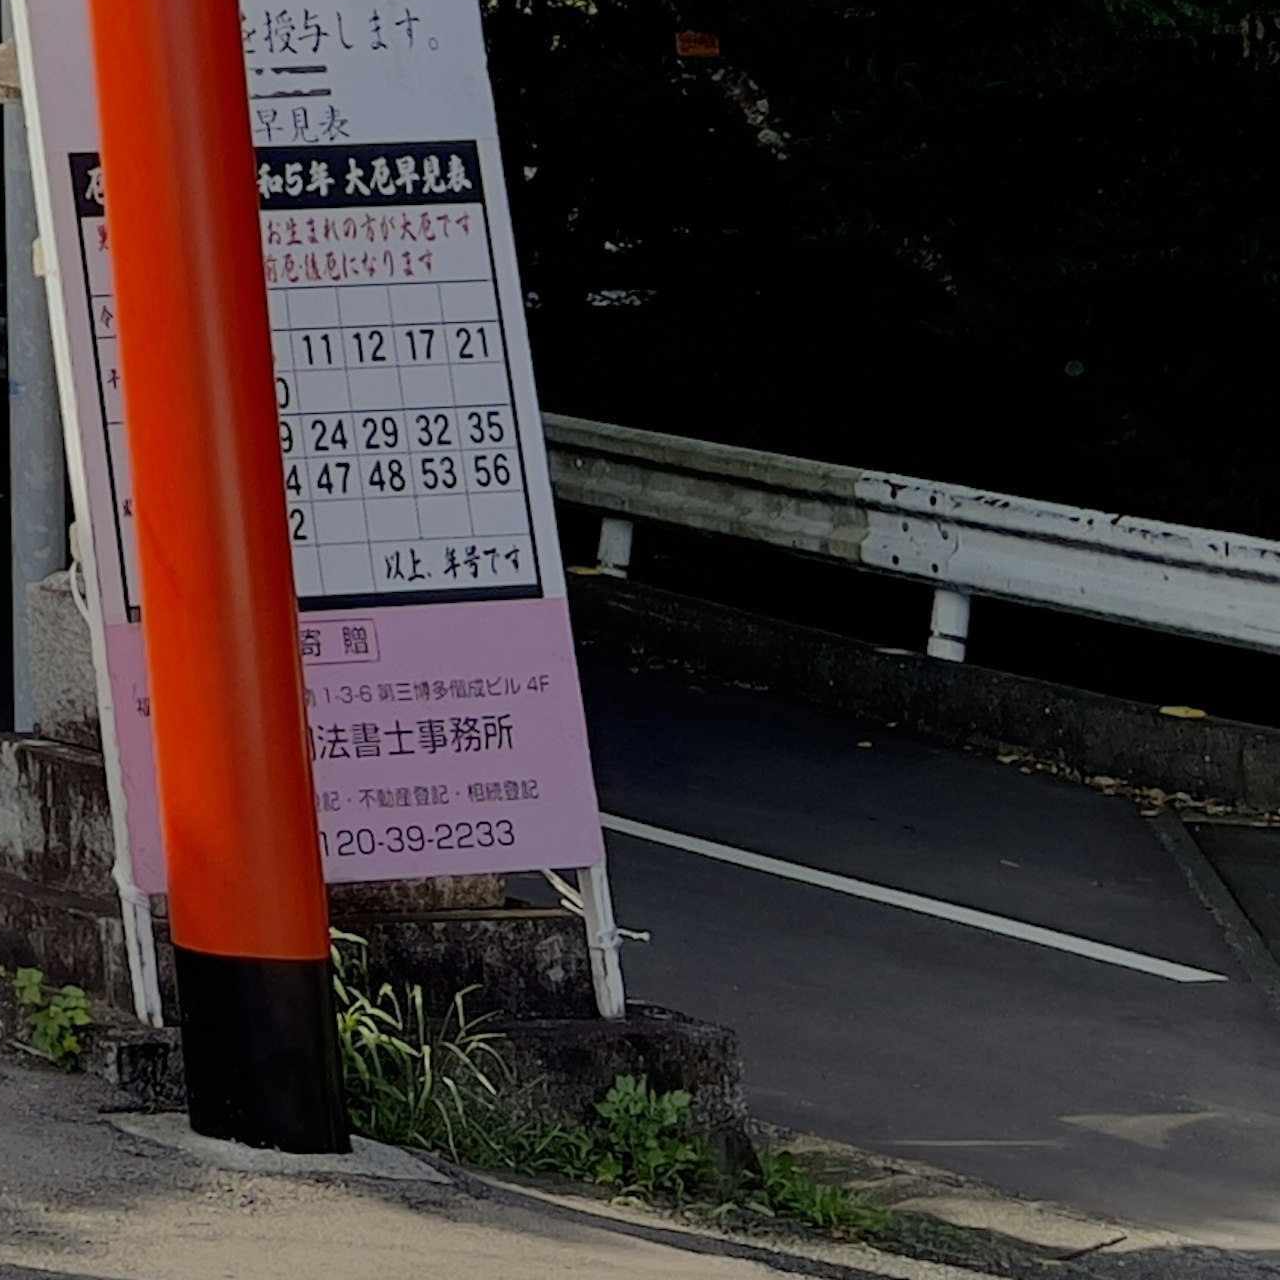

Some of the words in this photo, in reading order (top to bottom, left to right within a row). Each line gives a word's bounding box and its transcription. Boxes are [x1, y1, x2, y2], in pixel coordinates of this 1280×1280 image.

[254, 105, 351, 143] 早見表
[344, 153, 473, 197] 大厄早見表
[266, 213, 471, 246] お生まれの方が大厄です
[302, 333, 332, 365] 11
[352, 331, 387, 363] 12
[405, 329, 435, 361] 17
[456, 327, 490, 359] 21
[311, 419, 348, 452] 24
[362, 416, 399, 450] 29
[415, 414, 452, 447] 32
[468, 410, 506, 443] 35
[317, 463, 351, 495] 47
[369, 459, 406, 492] 48
[422, 456, 458, 490] 53
[474, 453, 511, 487] 56
[324, 686, 374, 704] 1-3-6
[527, 674, 551, 693] 4F
[310, 713, 514, 761] 法書士事務所
